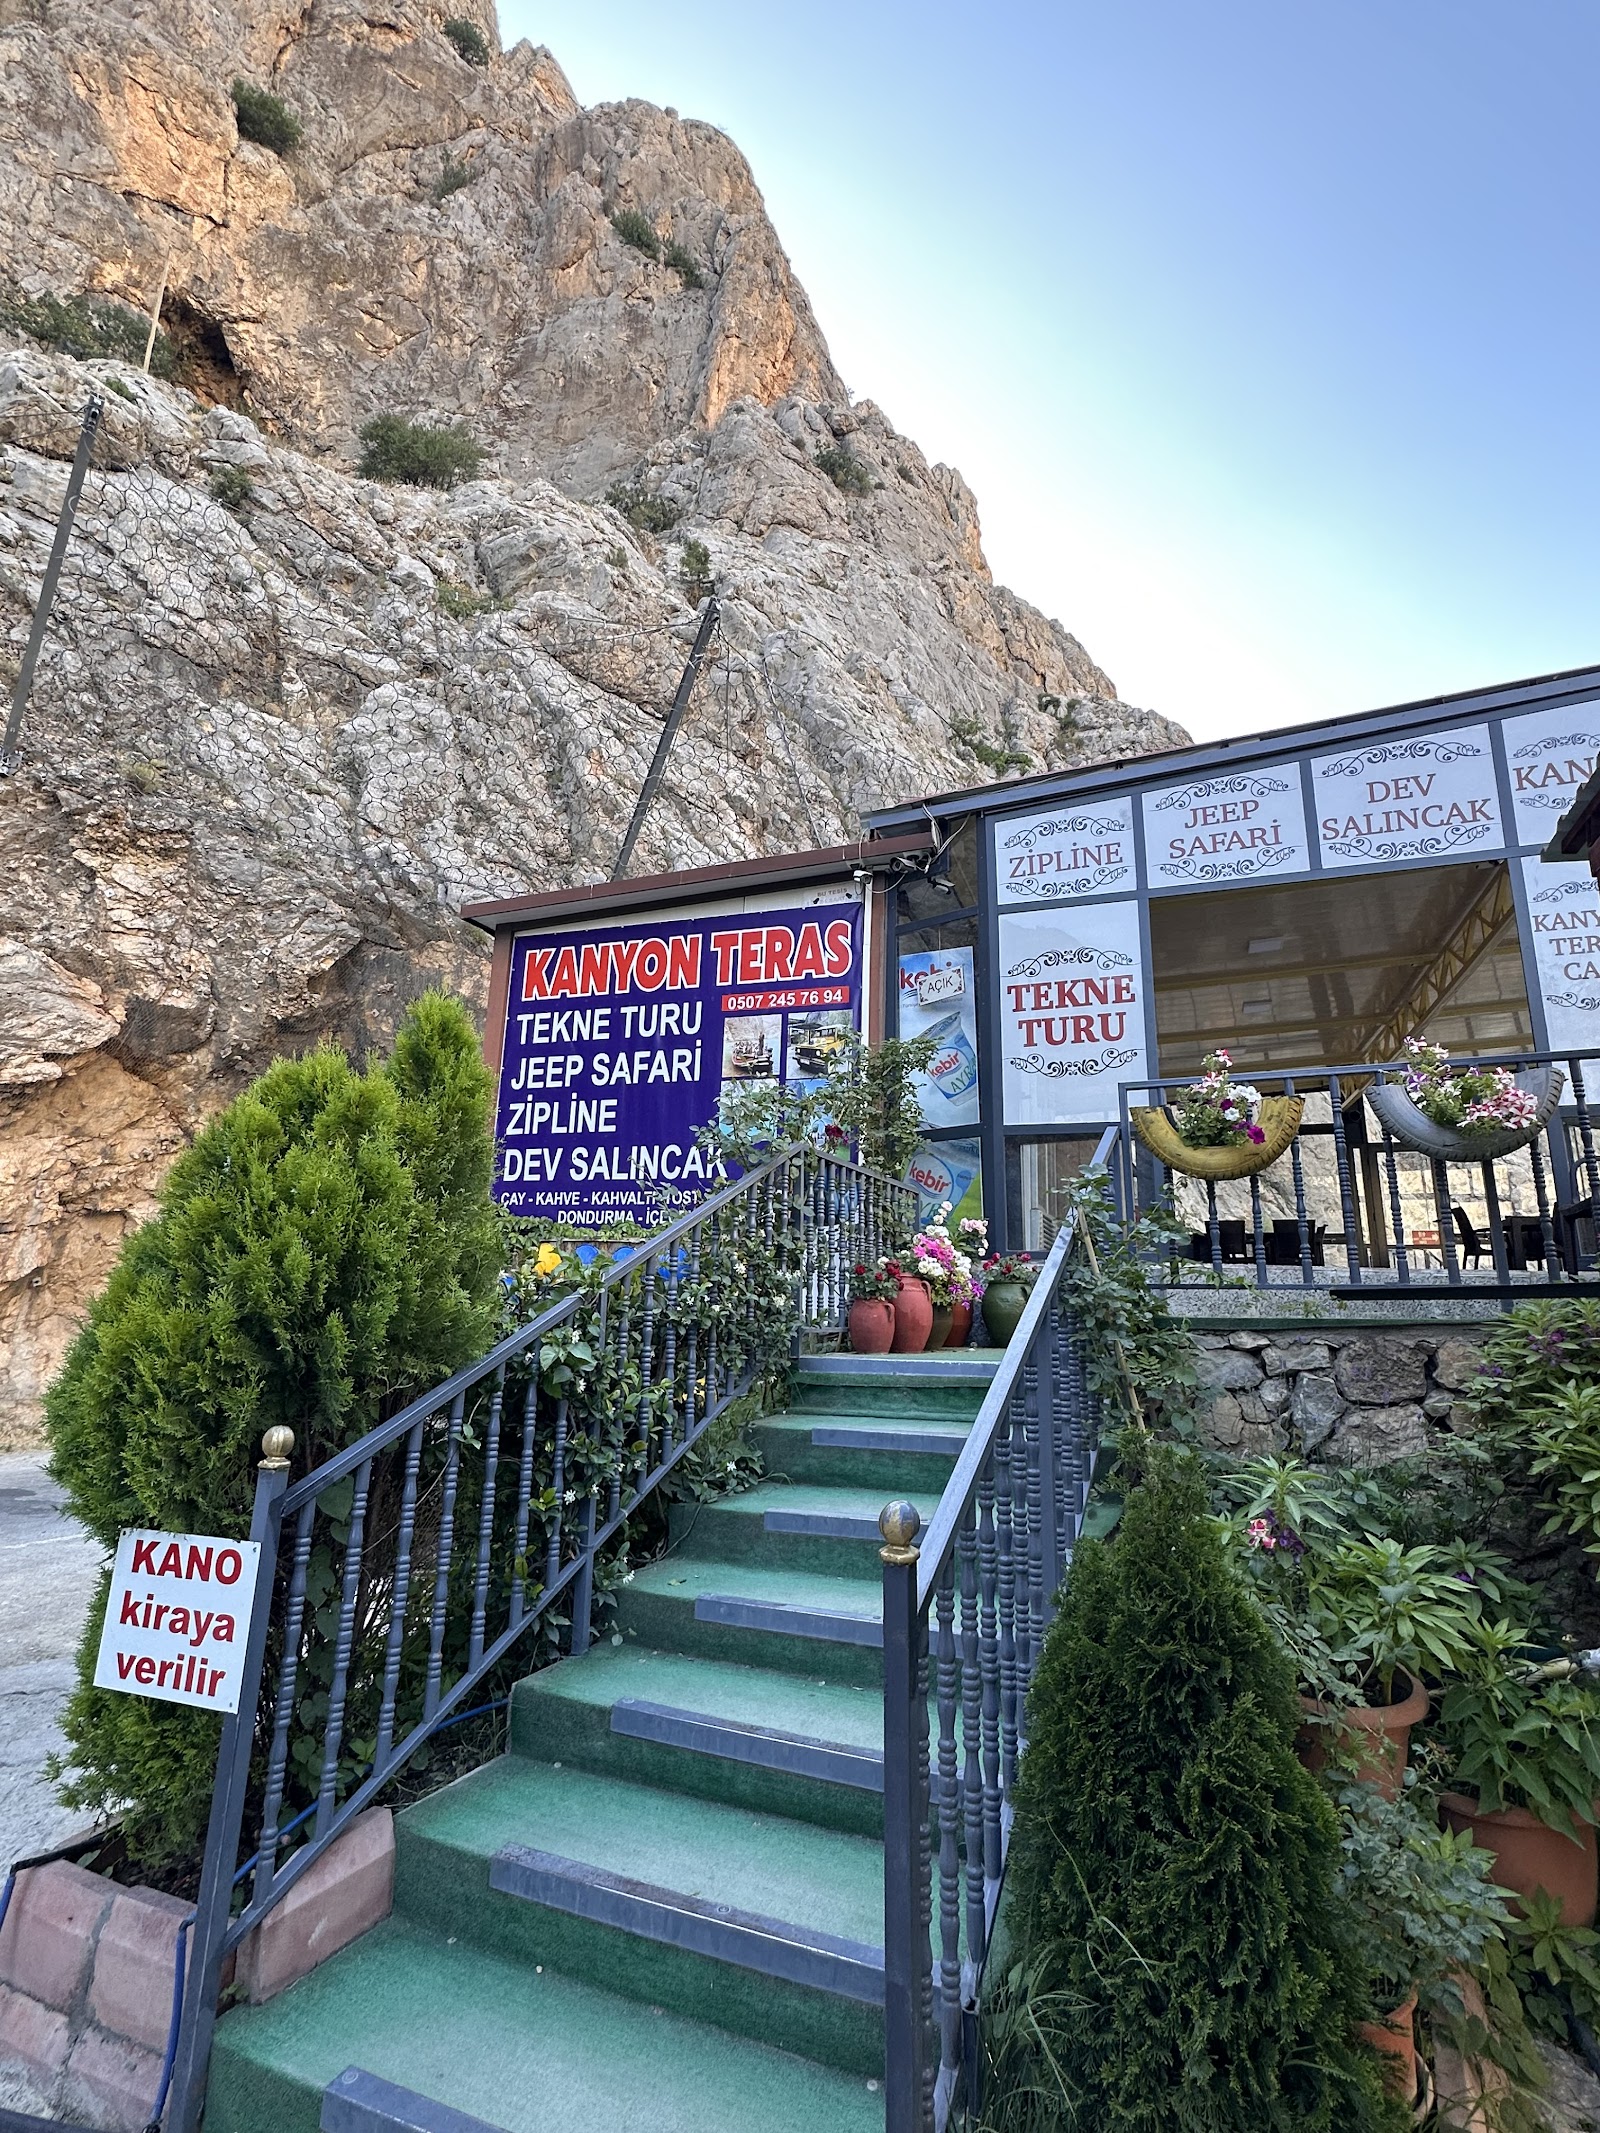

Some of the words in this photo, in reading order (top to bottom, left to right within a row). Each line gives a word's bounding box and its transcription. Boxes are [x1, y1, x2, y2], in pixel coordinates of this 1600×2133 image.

[1366, 773, 1436, 804] DEV
[1185, 799, 1259, 829] JEEP
[1322, 798, 1495, 841] SALINCAK
[1169, 819, 1282, 859] SAFARİ
[1009, 842, 1123, 879] ZİPLİNE
[521, 933, 703, 1002] KANYON
[710, 919, 853, 986] TERAS
[727, 994, 764, 1010] 0507
[768, 992, 796, 1008] 245
[800, 990, 819, 1005] 76
[823, 989, 843, 1003] 94
[927, 976, 953, 994] AÇIK
[1007, 974, 1136, 1012] TEKNE
[517, 1007, 611, 1045] TEKNE
[620, 1001, 703, 1039] TURU
[1018, 1012, 1126, 1048] TURU
[510, 1055, 584, 1090] JEEP
[591, 1040, 703, 1086] SAFARİ
[927, 1050, 960, 1078] kebir
[506, 1092, 618, 1136] ZİPLİNE
[503, 1147, 564, 1182] DEV
[570, 1144, 729, 1181] SALINCAK
[909, 1160, 949, 1193] kebir
[500, 1192, 527, 1207] ÇAY
[535, 1191, 580, 1206] KAHVE
[557, 1209, 635, 1225] DONDURMA
[131, 1539, 242, 1585] KANO
[119, 1590, 235, 1647] kiraya
[116, 1652, 226, 1697] verilir
